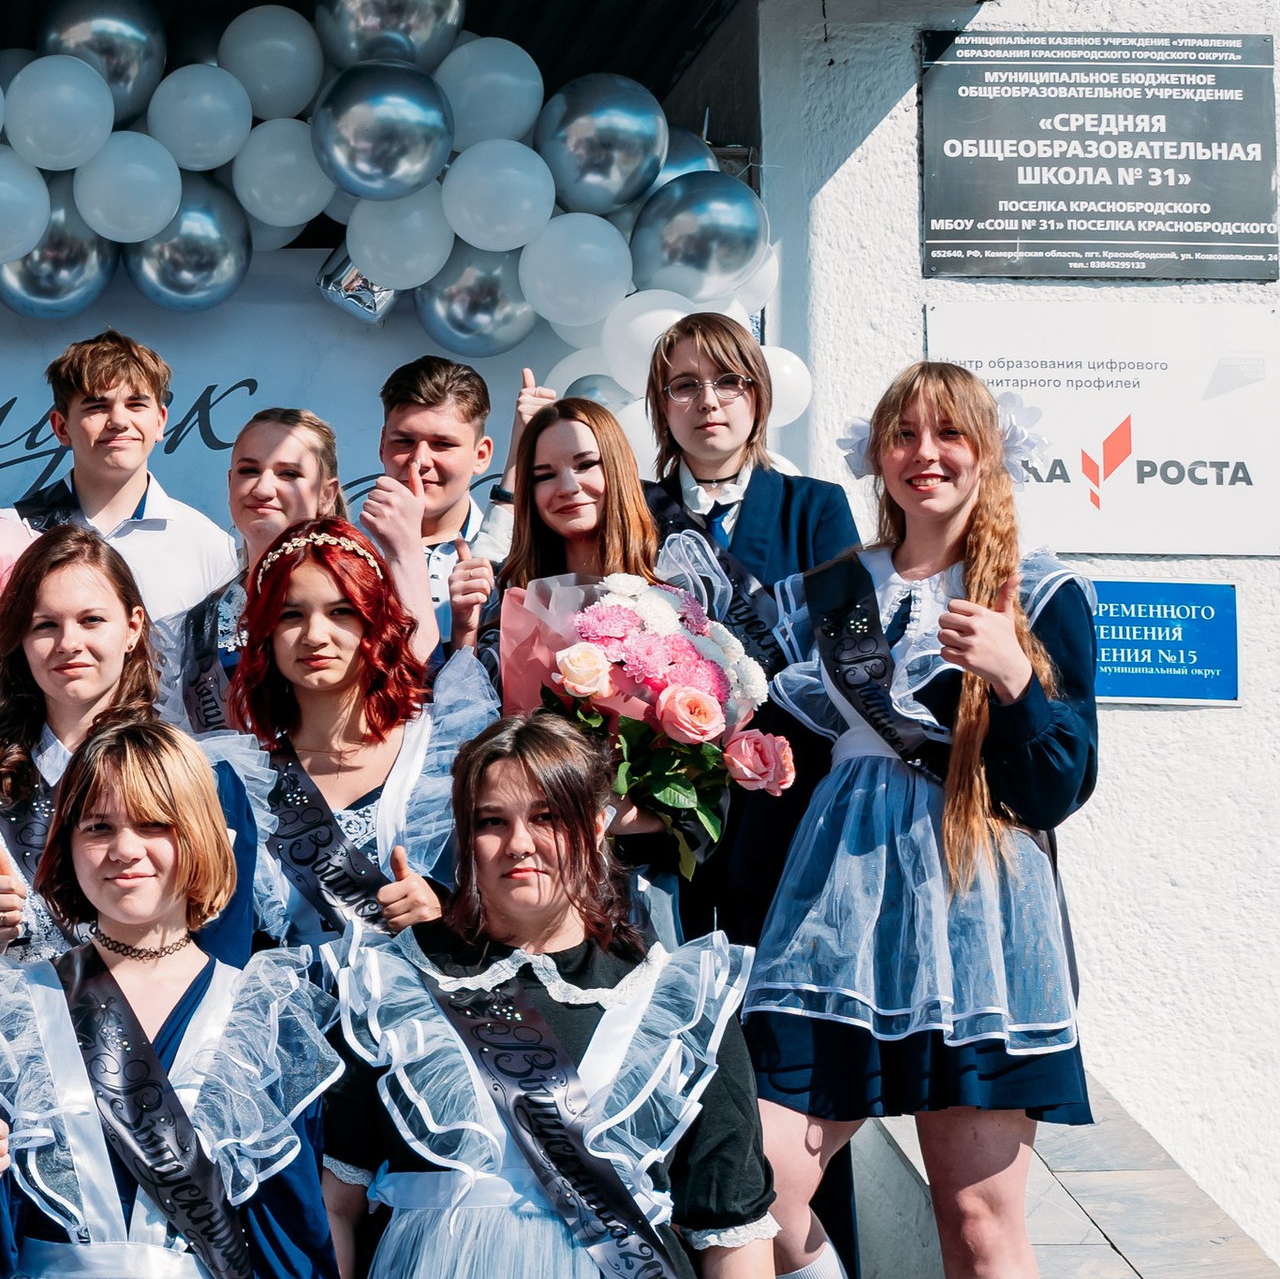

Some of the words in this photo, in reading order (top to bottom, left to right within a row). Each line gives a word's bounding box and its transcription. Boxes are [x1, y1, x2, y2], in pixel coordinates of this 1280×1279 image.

[954, 36, 1047, 46] МУНИЦИПАЛЬНОЕ
[1049, 37, 1101, 46] КАЗЕННОЕ
[1102, 38, 1171, 48] УЧРЕЖДЕНИЕ
[1172, 38, 1242, 48] «УПРАВЛЕНИЕ
[956, 49, 1030, 59] ОБРАЗОВАНИЯ
[1031, 50, 1130, 60] КРАСНОБРОДСКОГО
[1132, 52, 1196, 61] ГОРОДСКОГО
[1198, 52, 1242, 61] ОКРУГА»
[985, 71, 1118, 85] МУНИЦИПАЛЬНОЕ
[1122, 72, 1216, 86] БЮДЖЕТНОЕ
[958, 86, 1142, 99] ОБЩЕОБРАЗОВАТЕЛЬНОЕ
[1144, 88, 1243, 101] УЧРЕЖДЕНИЕ
[1039, 113, 1167, 135] «СРЕДНЯЯ
[943, 139, 1262, 161] ОБЩЕОБРАЗОВАТЕЛЬНАЯ
[1017, 167, 1113, 185] ШКОЛА
[1118, 167, 1143, 186] №
[1148, 168, 1192, 186] 31»
[998, 200, 1067, 212] ПОСЕЛКА
[1069, 201, 1211, 215] КРАСНОБРОДСКОГО
[930, 218, 974, 230] МБОУ
[976, 219, 1018, 231] «СОШ
[1022, 219, 1037, 231] №
[1039, 219, 1064, 231] 31»
[1067, 219, 1136, 232] ПОСЕЛКА
[1138, 221, 1277, 236] КРАСНОБРОДСКОГО
[988, 357, 1082, 372] образования
[1087, 358, 1169, 373] цифрового
[982, 377, 1061, 390] нитарного
[1066, 377, 1140, 391] профилей
[1135, 459, 1254, 486] РОСТА
[1092, 602, 1216, 621] РЕМЕННОГО
[1094, 624, 1183, 642] ЕЩЕНИЯ
[1156, 648, 1198, 665] №15
[1099, 665, 1188, 677] муниципальный
[1190, 667, 1222, 679] округ
